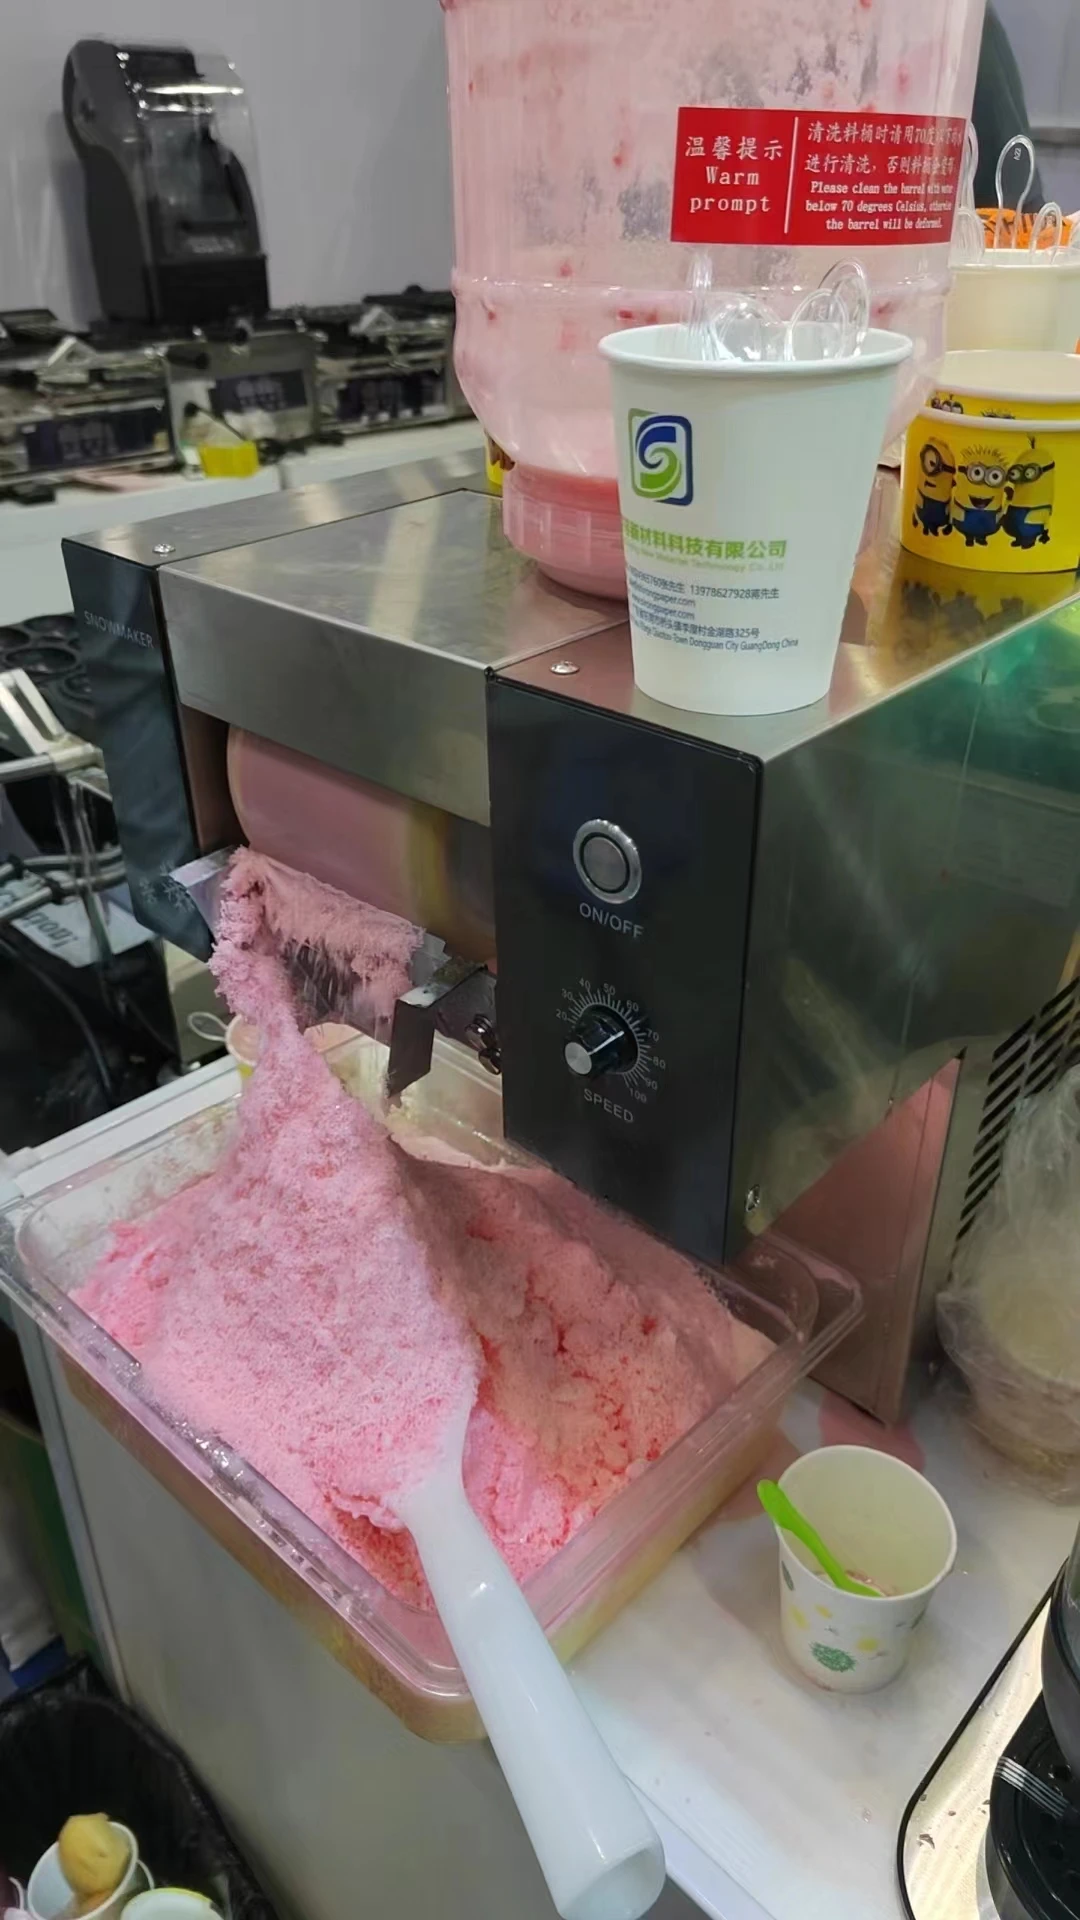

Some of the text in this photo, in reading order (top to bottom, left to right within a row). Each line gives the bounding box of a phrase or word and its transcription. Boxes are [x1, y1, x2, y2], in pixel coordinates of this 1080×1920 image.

[684, 135, 783, 161] 温馨提示
[705, 165, 760, 186] Warm
[810, 180, 849, 194] Please
[852, 182, 880, 195] clean
[883, 182, 898, 195] the
[900, 182, 926, 195] barrel
[689, 195, 772, 215] prompt
[805, 199, 838, 213] below
[841, 199, 855, 213] 70
[856, 200, 894, 214] degrees
[895, 199, 927, 213] Celsius,
[825, 217, 844, 231] the
[847, 218, 880, 231] barrel
[882, 217, 902, 230] will
[904, 217, 913, 229] be
[83, 610, 154, 649] SNOWMAKER
[689, 636, 724, 652] Dongguan
[725, 641, 739, 652] City
[740, 640, 781, 652] GuangDong
[579, 902, 645, 939] ON/OFF
[603, 982, 616, 996] 50
[626, 999, 639, 1013] 60
[555, 1008, 568, 1021] 20
[646, 1028, 660, 1042] 70
[653, 1056, 666, 1070] 80
[645, 1079, 658, 1091] 90
[629, 1087, 647, 1104] 100
[583, 1088, 634, 1123] SPEED
